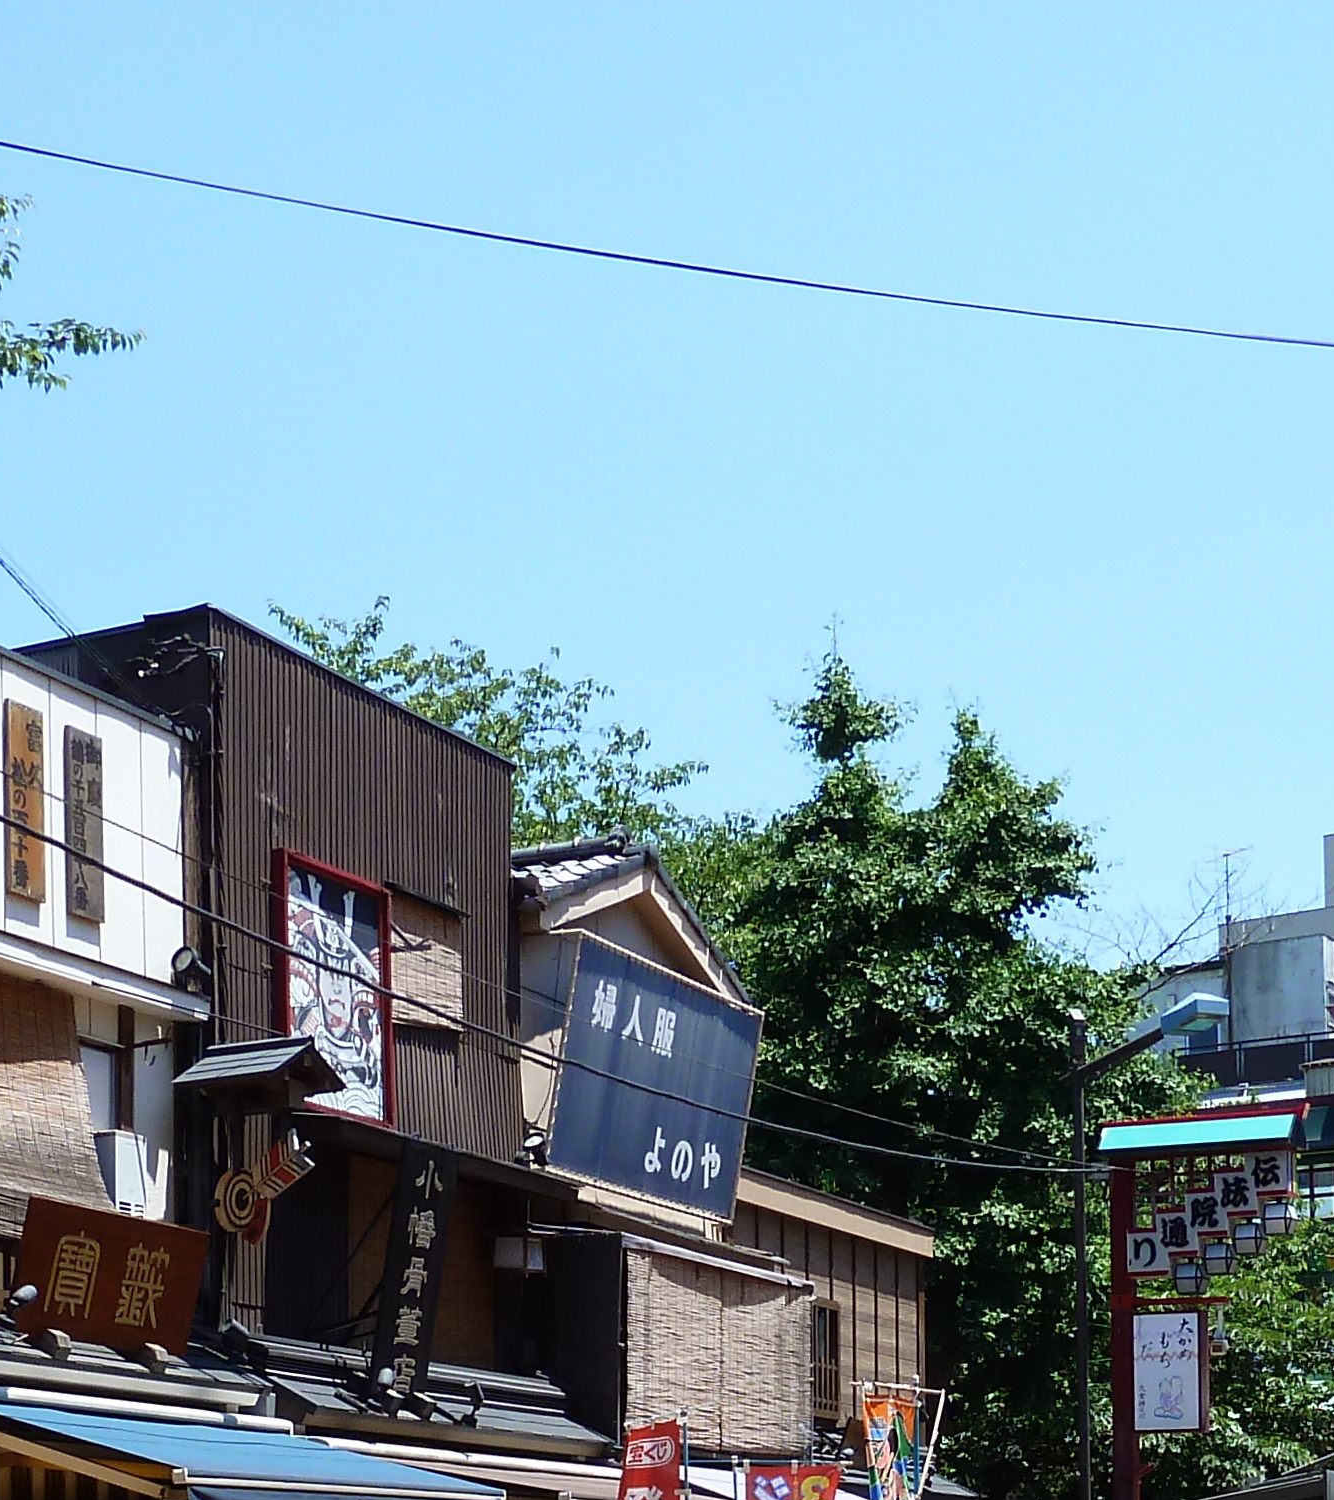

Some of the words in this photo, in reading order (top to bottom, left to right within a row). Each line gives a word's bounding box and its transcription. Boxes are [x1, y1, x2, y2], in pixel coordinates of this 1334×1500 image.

[590, 979, 675, 1059] 婦人服
[643, 1126, 722, 1190] よのや
[628, 1441, 667, 1464] 宝くじ
